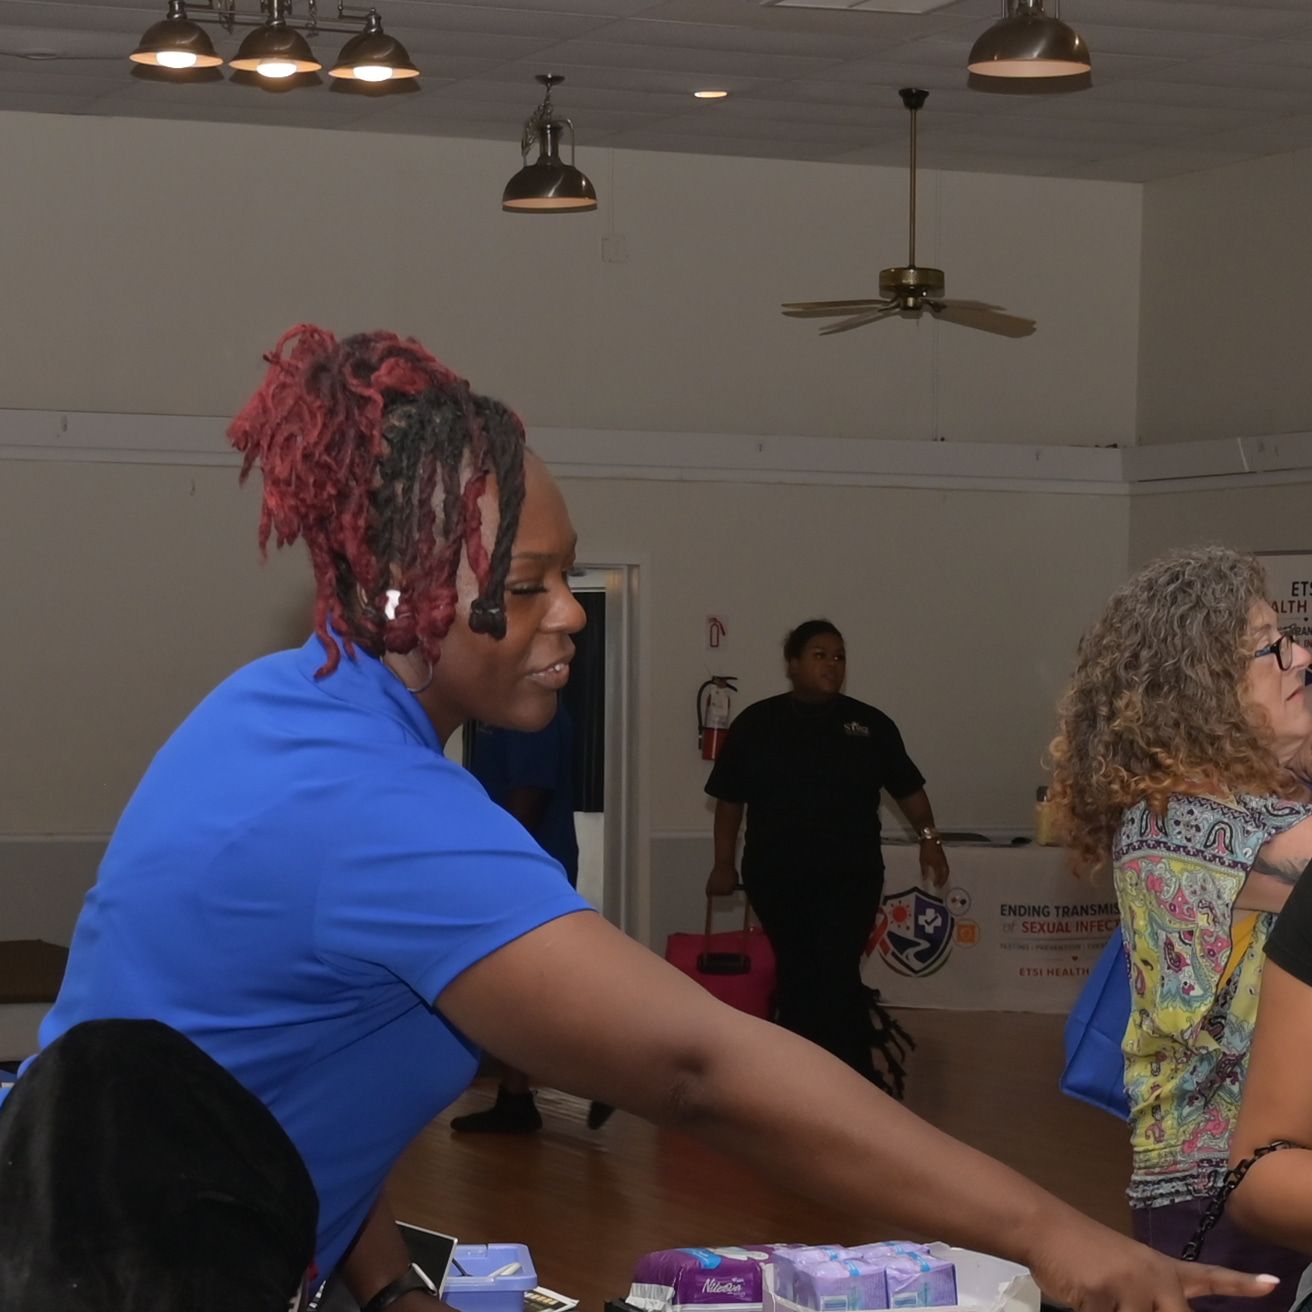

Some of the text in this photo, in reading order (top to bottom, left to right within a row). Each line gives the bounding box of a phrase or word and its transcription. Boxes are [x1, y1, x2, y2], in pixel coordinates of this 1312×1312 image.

[1271, 599, 1307, 614] ALTH
[1000, 903, 1120, 917] ENDING TRANSMIS
[1022, 921, 1071, 933] SEXUAL
[1076, 919, 1120, 932] INFECT
[1019, 967, 1089, 977] ETSI HEALTH
